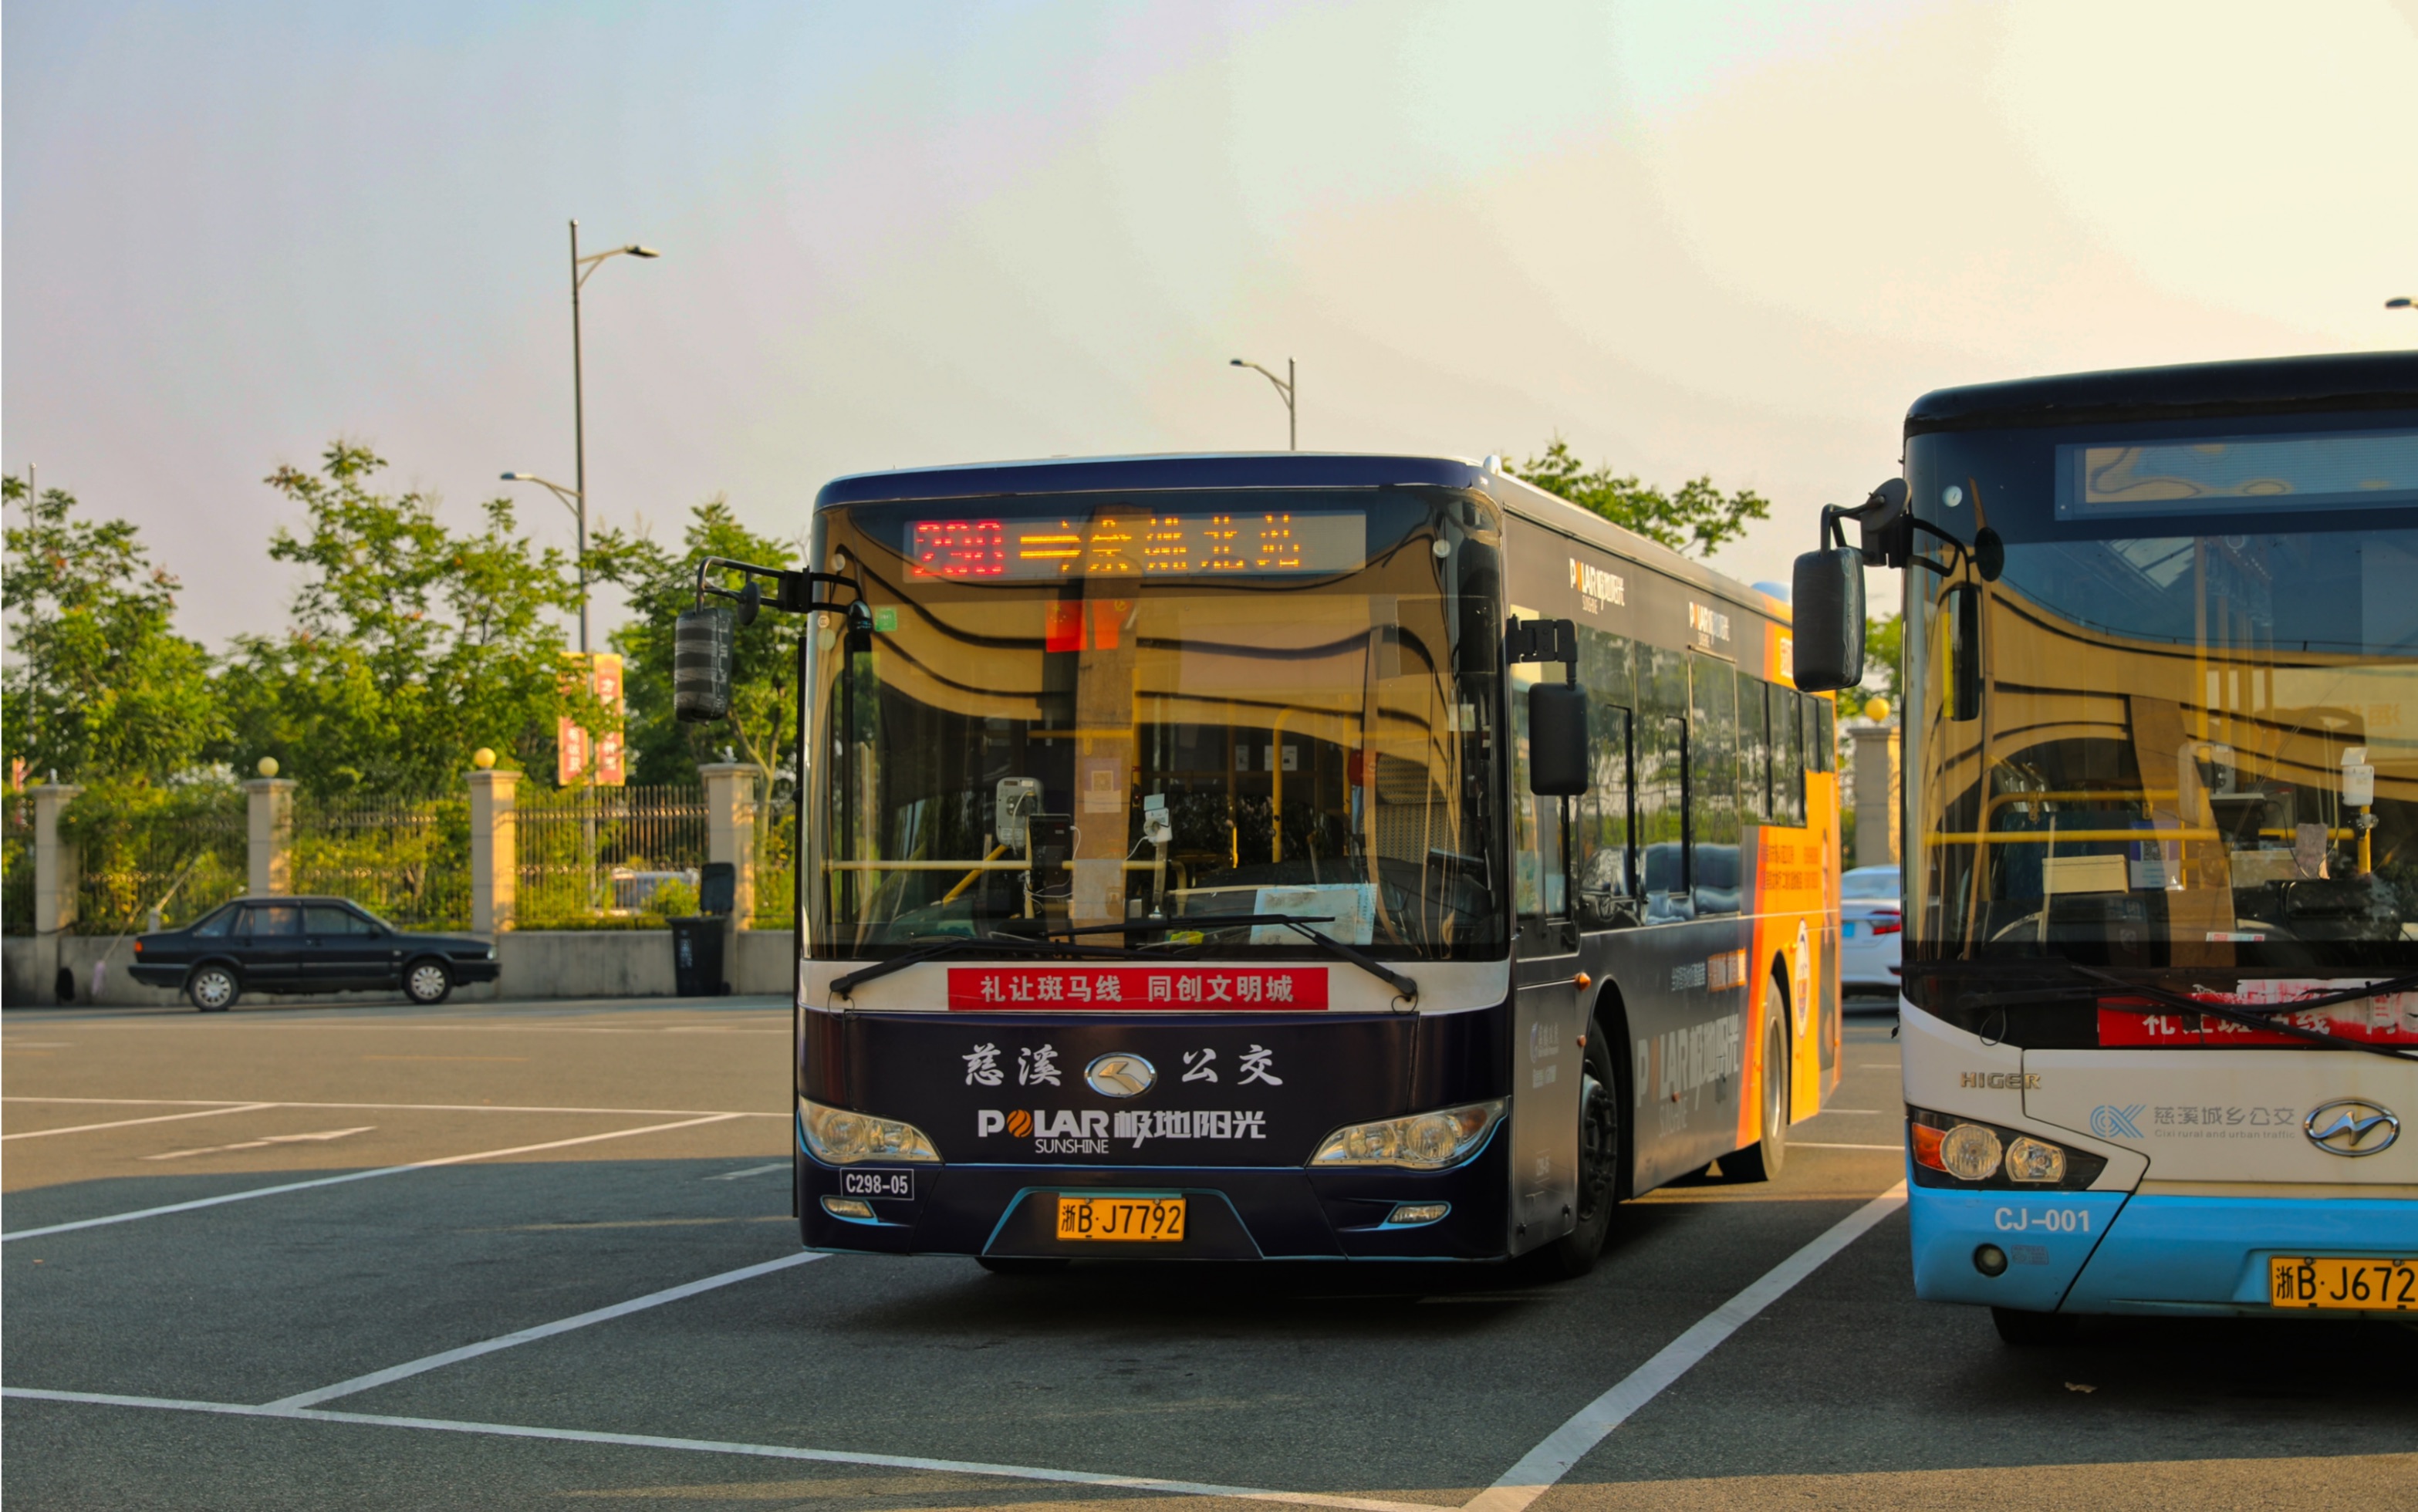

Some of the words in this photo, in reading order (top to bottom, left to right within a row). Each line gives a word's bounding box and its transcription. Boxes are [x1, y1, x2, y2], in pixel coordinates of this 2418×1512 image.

[981, 975, 1122, 1002] 礼让斑马线
[1147, 975, 1294, 1002] 同创文明城
[962, 1042, 1062, 1086] 慈溪
[1182, 1045, 1283, 1085] 公交
[1960, 1072, 2041, 1089] HIGER
[2153, 1106, 2295, 1126] 慈溪城乡公交
[978, 1109, 1109, 1138] POLAR
[1113, 1110, 1267, 1148] 极地阳光
[2154, 1129, 2176, 1138] Cixi
[2177, 1129, 2204, 1138] rural
[2206, 1129, 2226, 1139] and
[2229, 1129, 2261, 1139] urban
[2262, 1129, 2295, 1139] traffic
[1035, 1139, 1109, 1154] SUNSHINE
[846, 1173, 909, 1194] C298-05
[1994, 1207, 2090, 1232] CJ-001
